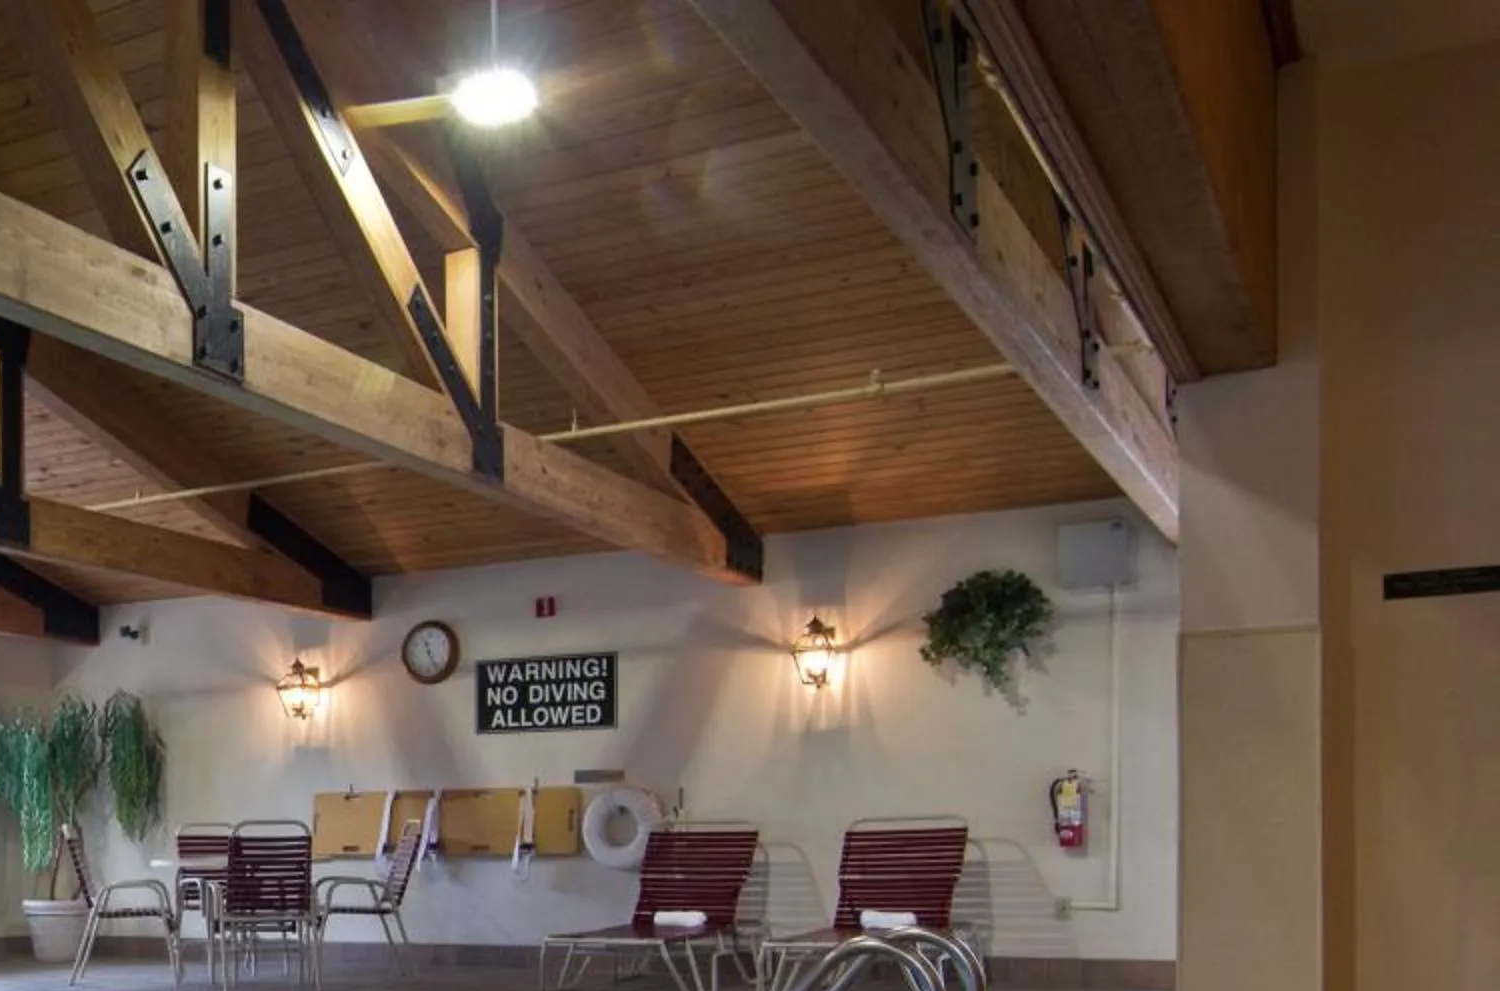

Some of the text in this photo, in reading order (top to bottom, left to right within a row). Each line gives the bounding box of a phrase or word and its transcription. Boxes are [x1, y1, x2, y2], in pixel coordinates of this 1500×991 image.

[486, 658, 608, 683] WARNING!
[487, 681, 606, 706] NO DIVING
[491, 704, 602, 728] ALLOWED
